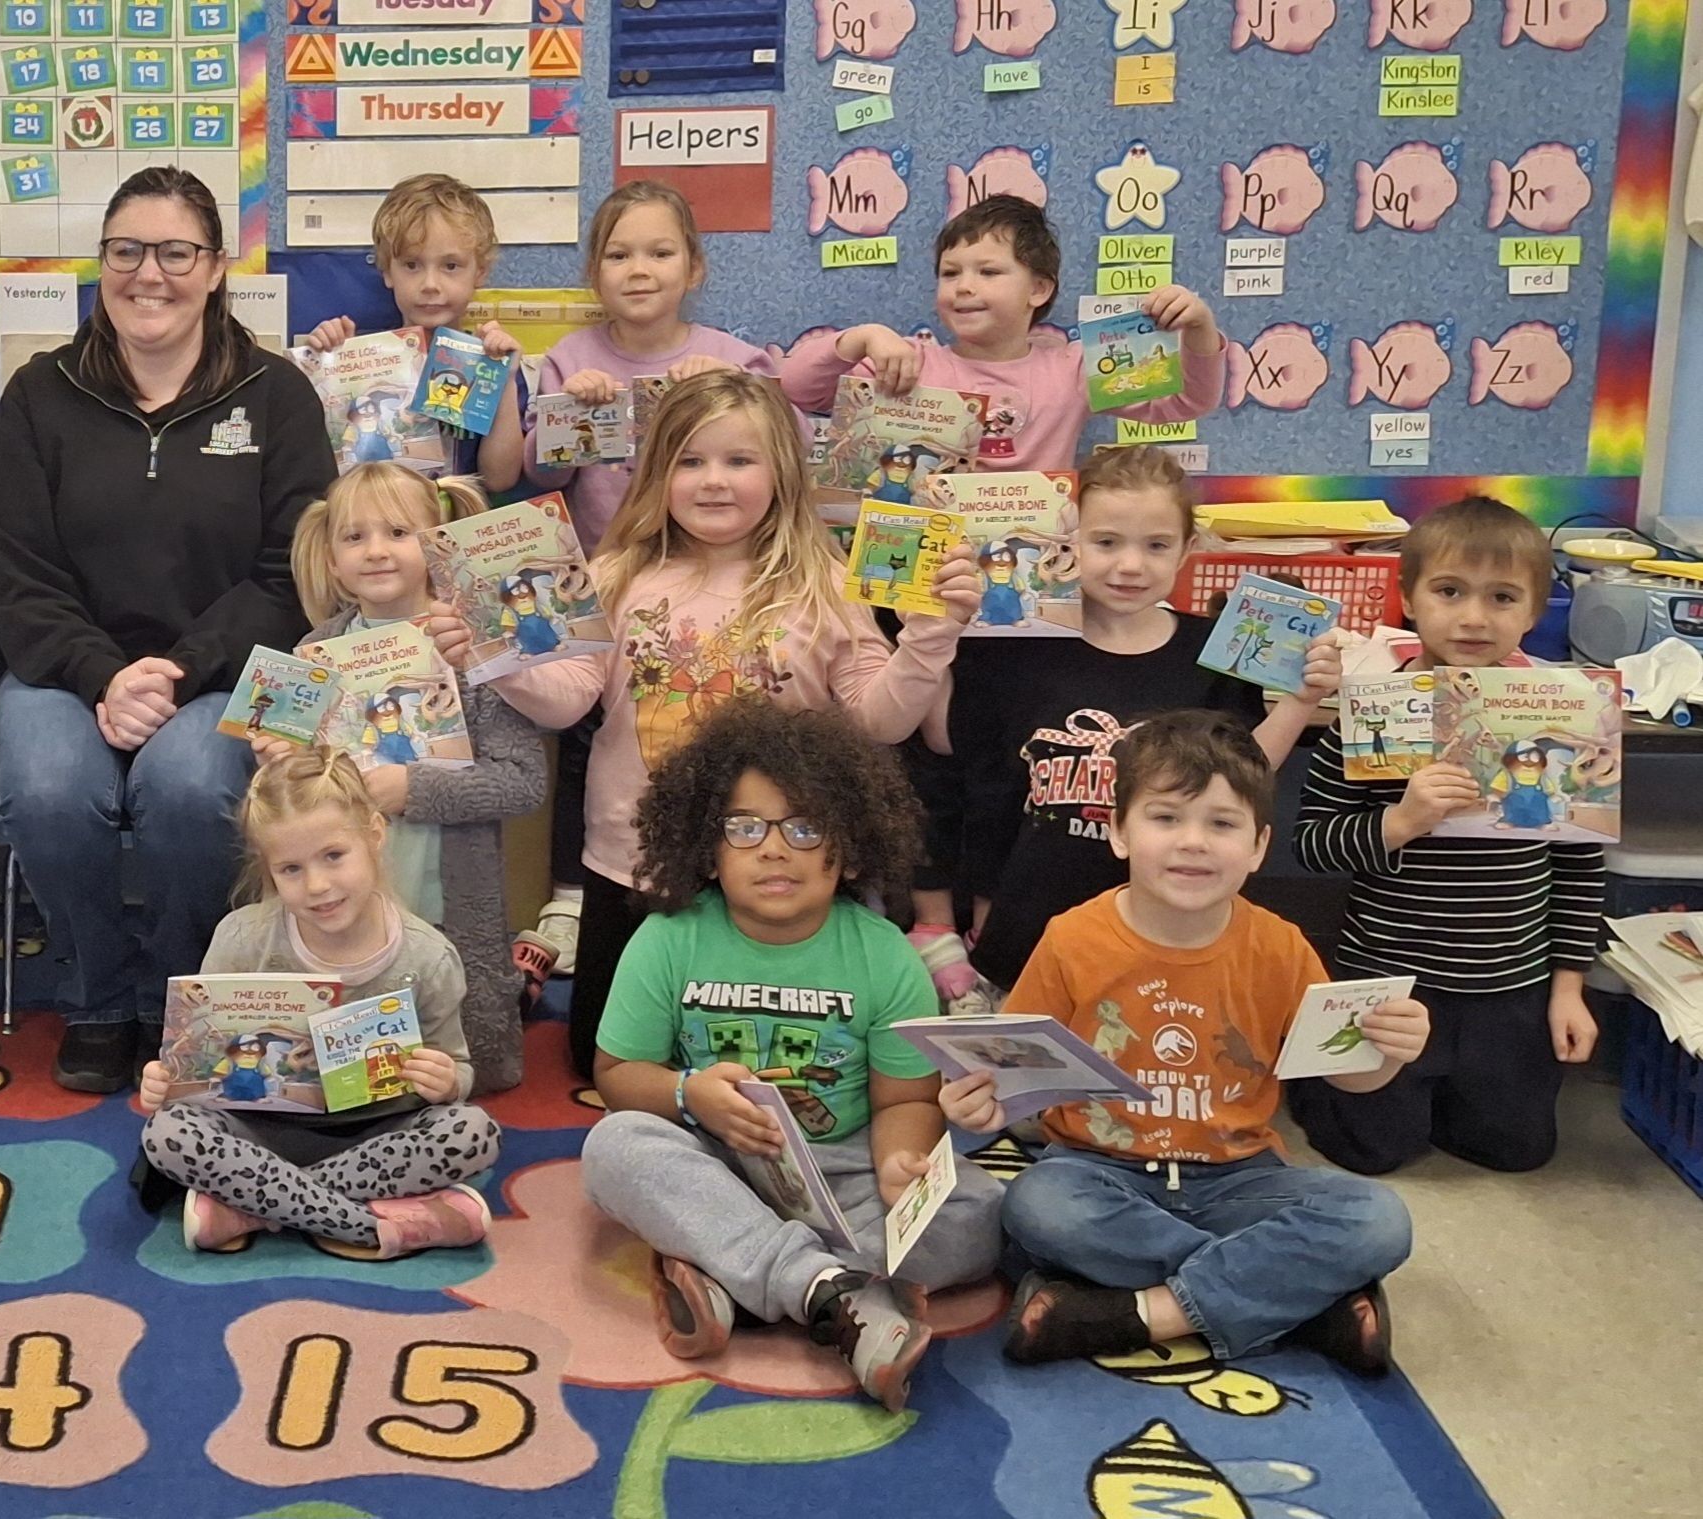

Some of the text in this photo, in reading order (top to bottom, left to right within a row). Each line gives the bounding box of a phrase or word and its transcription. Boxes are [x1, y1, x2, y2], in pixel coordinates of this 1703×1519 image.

[16, 10, 36, 25] 10
[78, 10, 95, 25] 11
[135, 11, 156, 26] 12
[199, 9, 220, 24] 13
[340, 38, 524, 70] Wednesday
[1141, 56, 1150, 70] I
[20, 64, 41, 80] 17
[79, 64, 101, 80] 18
[138, 66, 158, 82] 19
[197, 64, 222, 79] 20
[839, 70, 887, 87] green
[993, 69, 1029, 83] have
[1383, 58, 1457, 83] Kingston
[1137, 82, 1151, 96] is
[1387, 91, 1454, 109] Kinslee
[361, 95, 504, 126] Thursday
[854, 105, 873, 124] go
[14, 118, 40, 134] 24
[135, 121, 162, 138] 26
[194, 120, 221, 136] 27
[628, 119, 759, 157] Helpers
[19, 173, 41, 190] 31
[967, 174, 991, 208] N
[1508, 169, 1546, 211] Rr
[829, 176, 877, 214] Mm
[1117, 177, 1158, 213] Oo
[1244, 172, 1276, 229] Pp
[1372, 173, 1414, 229] Qq
[832, 243, 889, 262] Micah
[1105, 240, 1166, 260] Oliver
[1229, 244, 1282, 264] purple
[1514, 241, 1565, 265] Riley
[1110, 270, 1157, 290] Otto
[1235, 273, 1271, 292] pink
[1523, 271, 1553, 286] red
[4, 286, 66, 302] Yesterday
[228, 289, 276, 300] morrow
[518, 304, 541, 317] tens
[1093, 303, 1123, 314] one
[1245, 349, 1283, 390] Xx
[1371, 347, 1407, 402] Yy
[1490, 349, 1525, 385] Zz
[1123, 421, 1186, 437] Willow
[1374, 418, 1426, 434] yellow
[1385, 445, 1413, 459] yes
[977, 486, 1030, 496] THE LOST
[959, 500, 1047, 512] DINOSAUR BONE
[475, 517, 522, 537] THE LOST
[464, 527, 543, 558] DINOSAUR BONE
[918, 535, 948, 554] Cat
[1237, 599, 1318, 637] Pete Cat
[351, 636, 398, 656] THE LOST
[338, 646, 419, 673] DINOSAUR BONE
[251, 668, 321, 703] Pete Cat
[1505, 683, 1564, 695] THE LOST
[1351, 699, 1390, 716] Pete
[1483, 697, 1585, 710] DINOSAUR BONE
[1032, 755, 1117, 806] CHAR
[233, 991, 289, 1000] THE LOST
[1137, 977, 1167, 998] Ready
[212, 1002, 306, 1013] DINOSAUR BONE
[682, 980, 854, 1018] MINECRAFT
[1152, 1000, 1205, 1020] explore
[324, 1017, 409, 1053] Pete Cat
[266, 1333, 539, 1461] 15
